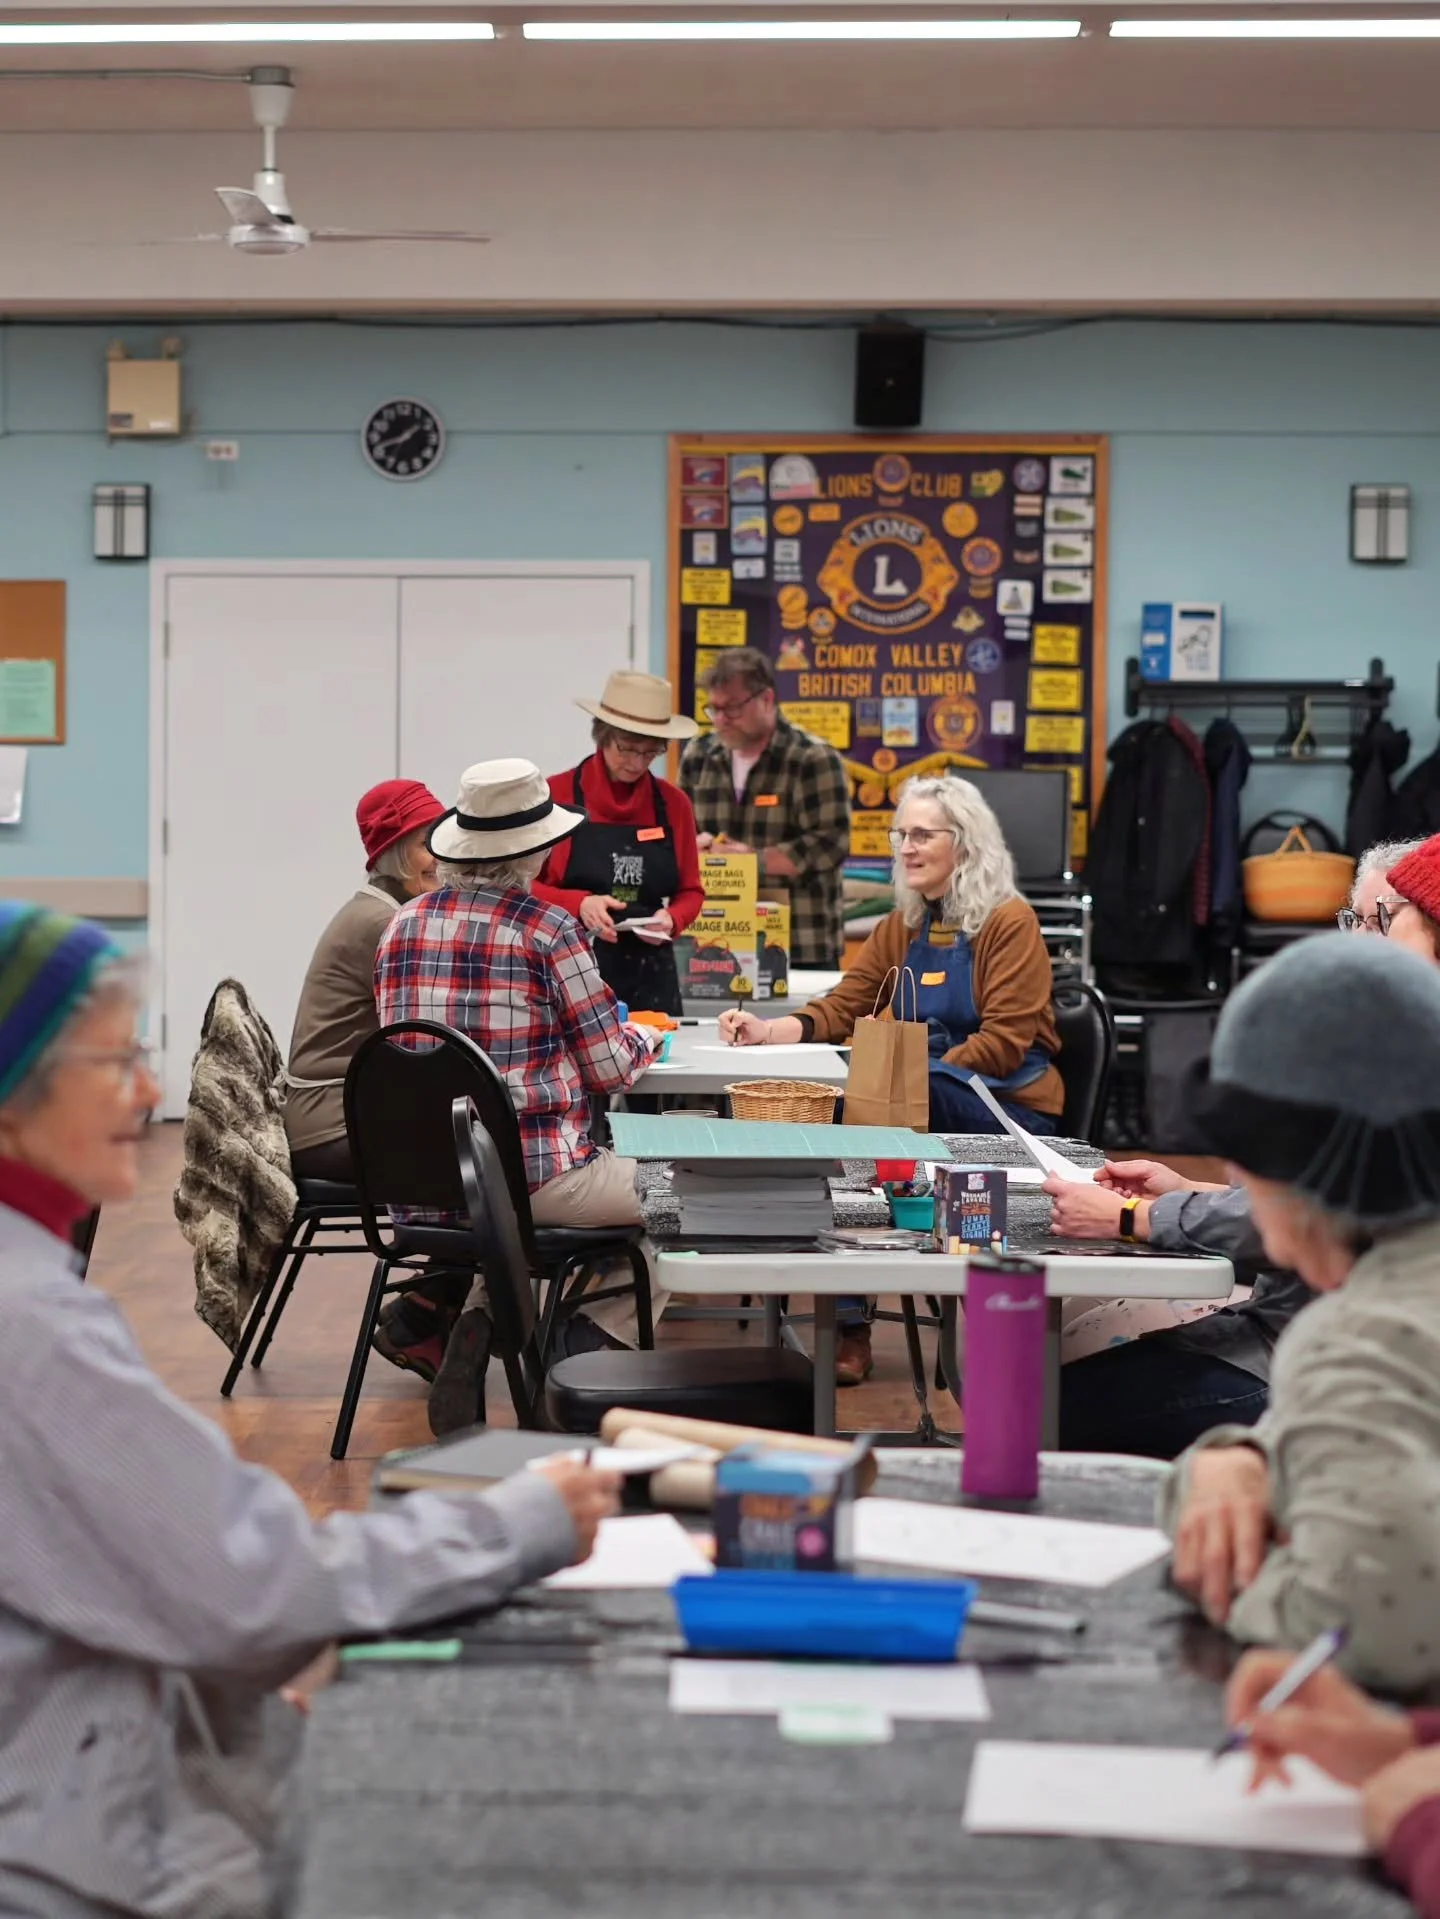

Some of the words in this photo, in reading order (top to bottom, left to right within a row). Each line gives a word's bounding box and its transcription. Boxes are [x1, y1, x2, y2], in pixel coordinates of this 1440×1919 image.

[816, 473, 873, 498] LIONS
[910, 473, 963, 498] CLUB
[850, 518, 925, 547] LIONS
[872, 555, 909, 596] L
[814, 644, 878, 668] COMOX
[891, 643, 963, 668] VALLEY
[799, 673, 872, 697] BRITISH
[880, 672, 977, 697] COLUMBIA
[612, 868, 643, 885] Arts
[712, 879, 746, 888] ORDURES
[725, 869, 744, 878] BAGS
[724, 921, 751, 932] BAGS
